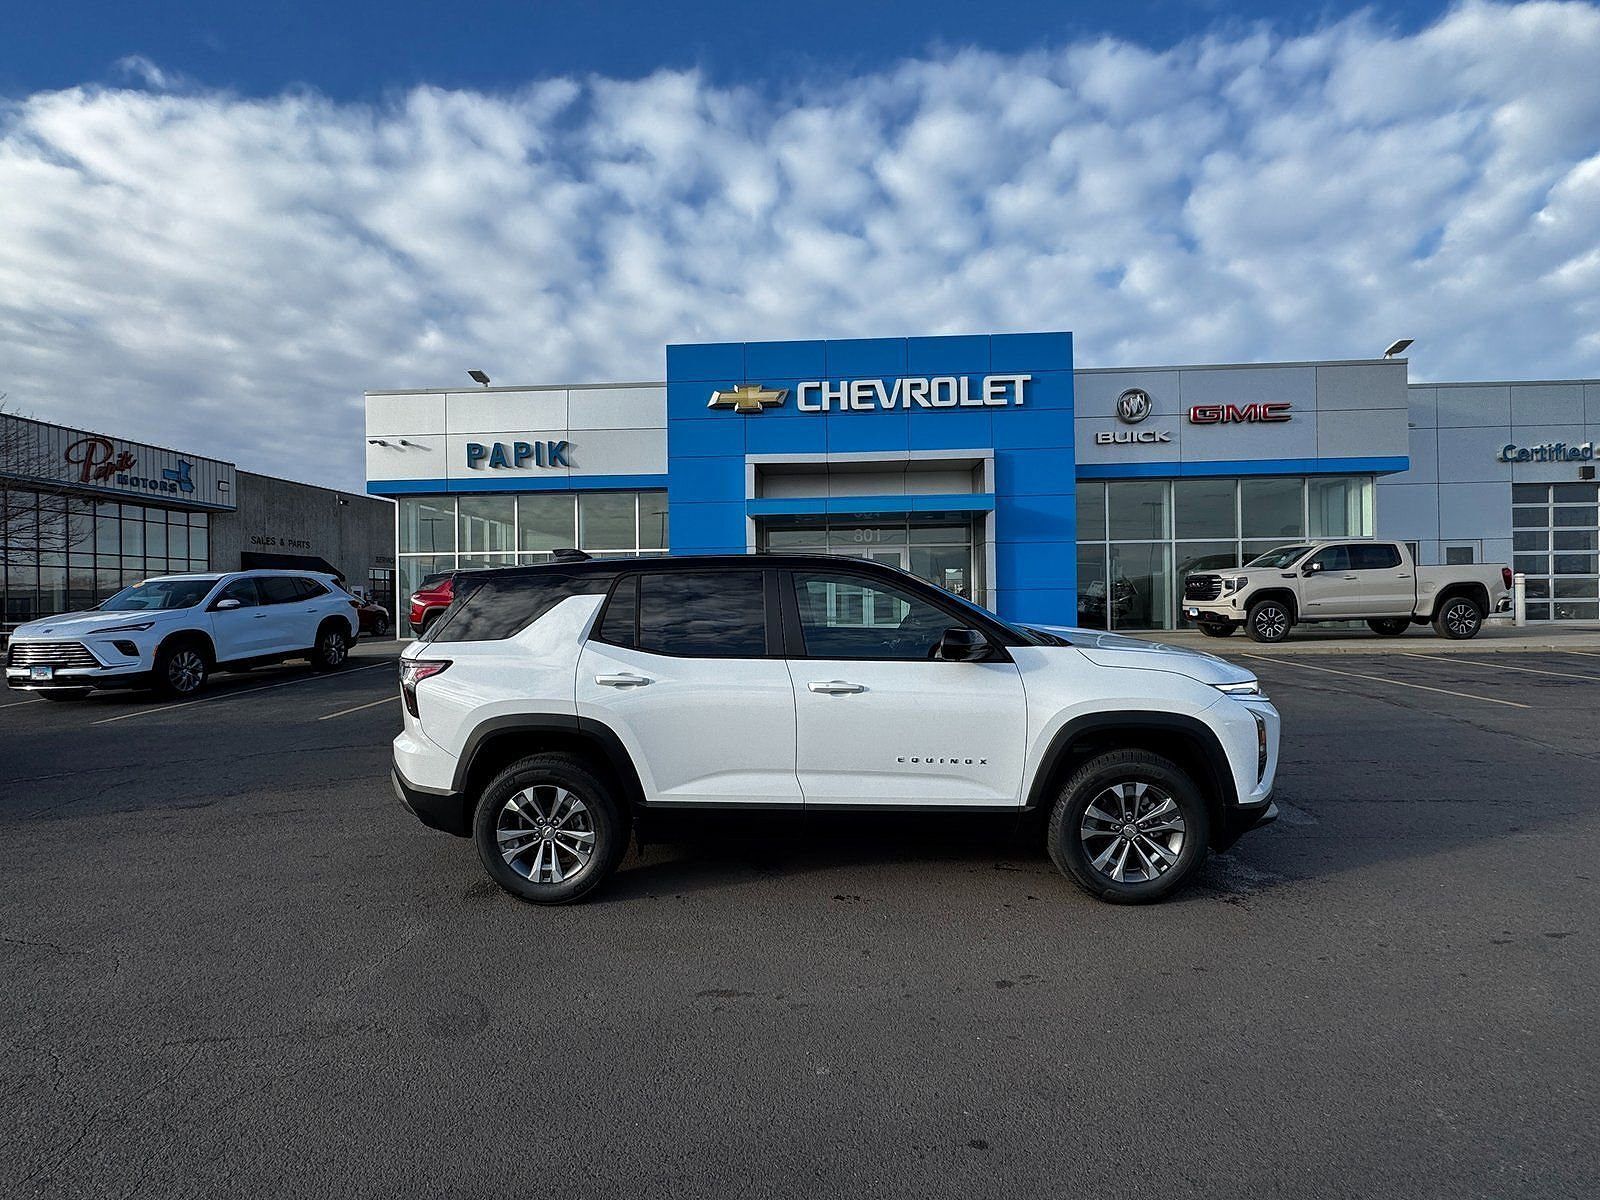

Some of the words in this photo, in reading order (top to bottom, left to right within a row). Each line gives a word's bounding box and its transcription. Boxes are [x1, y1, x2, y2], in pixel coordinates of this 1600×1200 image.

[797, 374, 1032, 411] CHEVROLET
[1188, 402, 1292, 424] GMC
[1096, 430, 1170, 445] BUICK
[466, 440, 570, 469] PAPIK
[1502, 441, 1594, 462] Certified
[116, 473, 178, 493] MOTORS
[251, 535, 276, 546] SALES
[279, 538, 285, 546] &
[288, 539, 311, 549] PARTS
[854, 528, 881, 542] 801
[897, 757, 987, 765] EQUINOX
